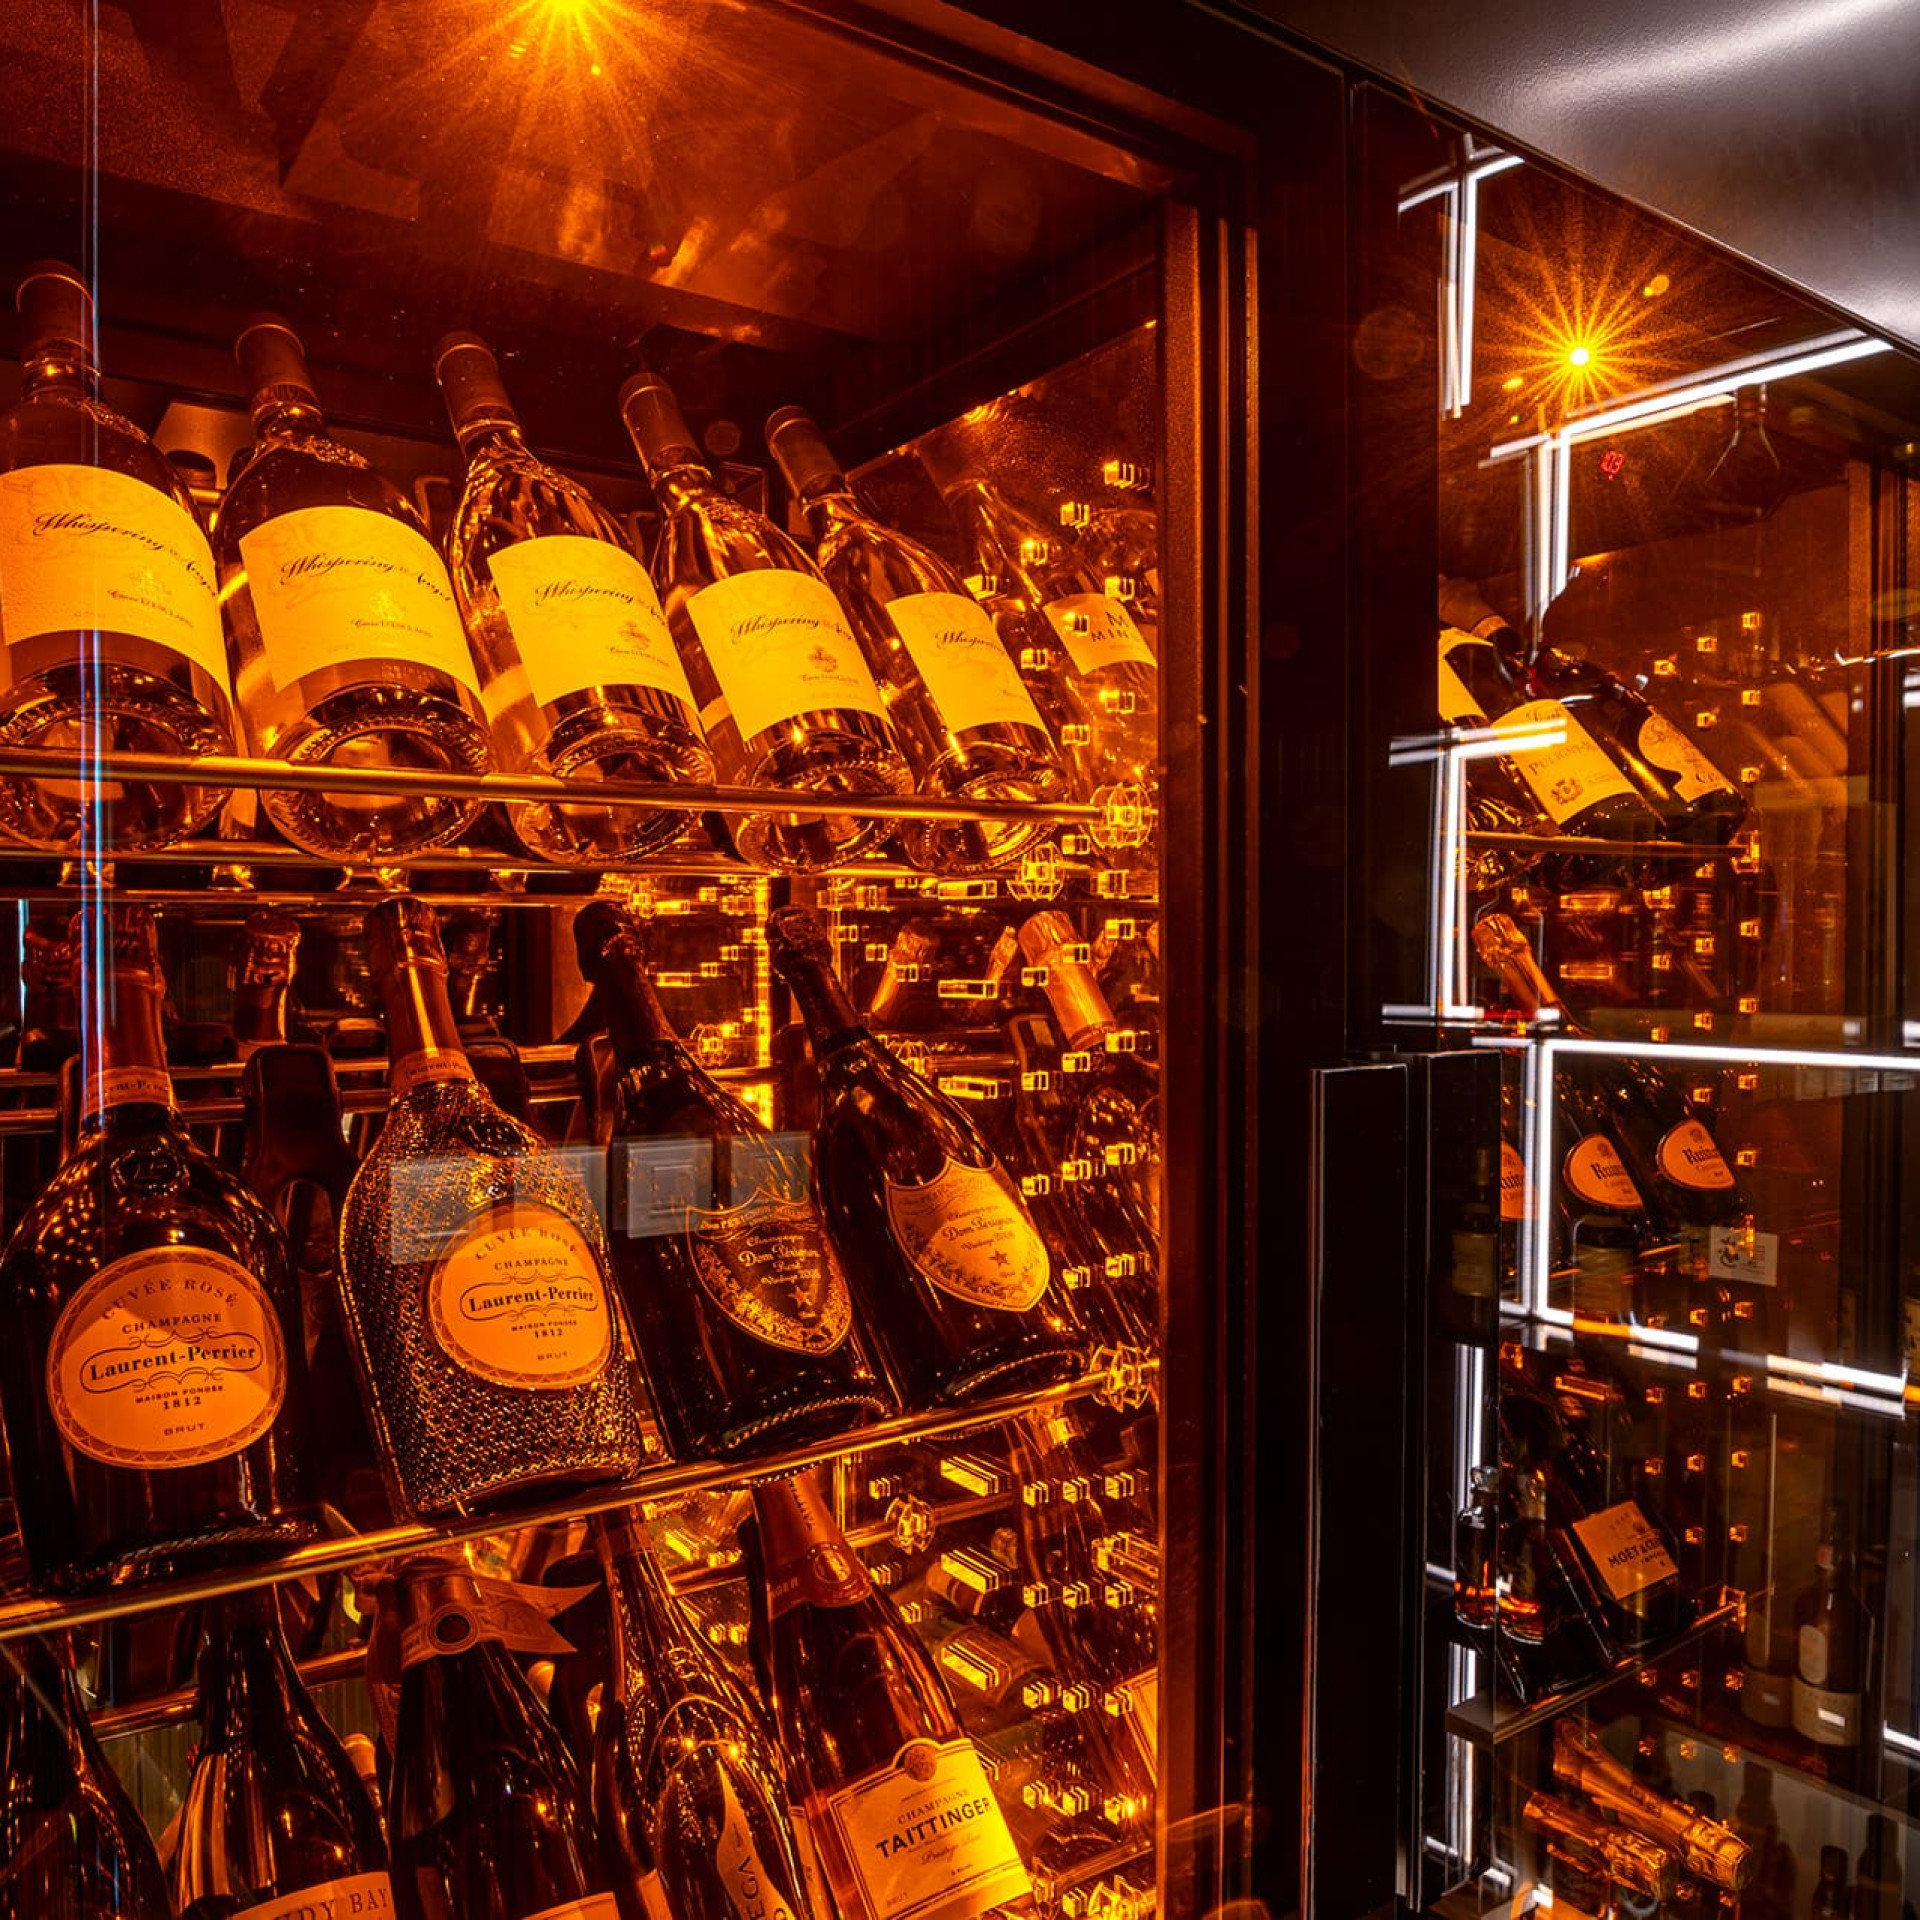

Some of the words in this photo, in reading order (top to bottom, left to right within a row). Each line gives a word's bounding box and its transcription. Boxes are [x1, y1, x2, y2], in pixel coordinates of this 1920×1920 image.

[32, 512, 164, 551] Whispering
[280, 552, 395, 586] Whispering
[534, 579, 635, 608] Whispering
[730, 613, 820, 646] Whispering
[493, 1256, 569, 1272] CHAMPAGNE
[468, 1286, 594, 1312] Laurent-Perrier
[121, 1312, 223, 1335] CHAMPAGNE
[534, 1327, 564, 1339] 1812
[89, 1344, 257, 1382] Laurent-Perrier
[537, 1350, 568, 1361] BRUT
[163, 1396, 202, 1411] 1812
[163, 1422, 205, 1437] BRUT
[897, 1788, 968, 1825] CHAMPAGNE
[875, 1797, 994, 1859] TAITTINGER
[350, 1887, 388, 1913] BAY
